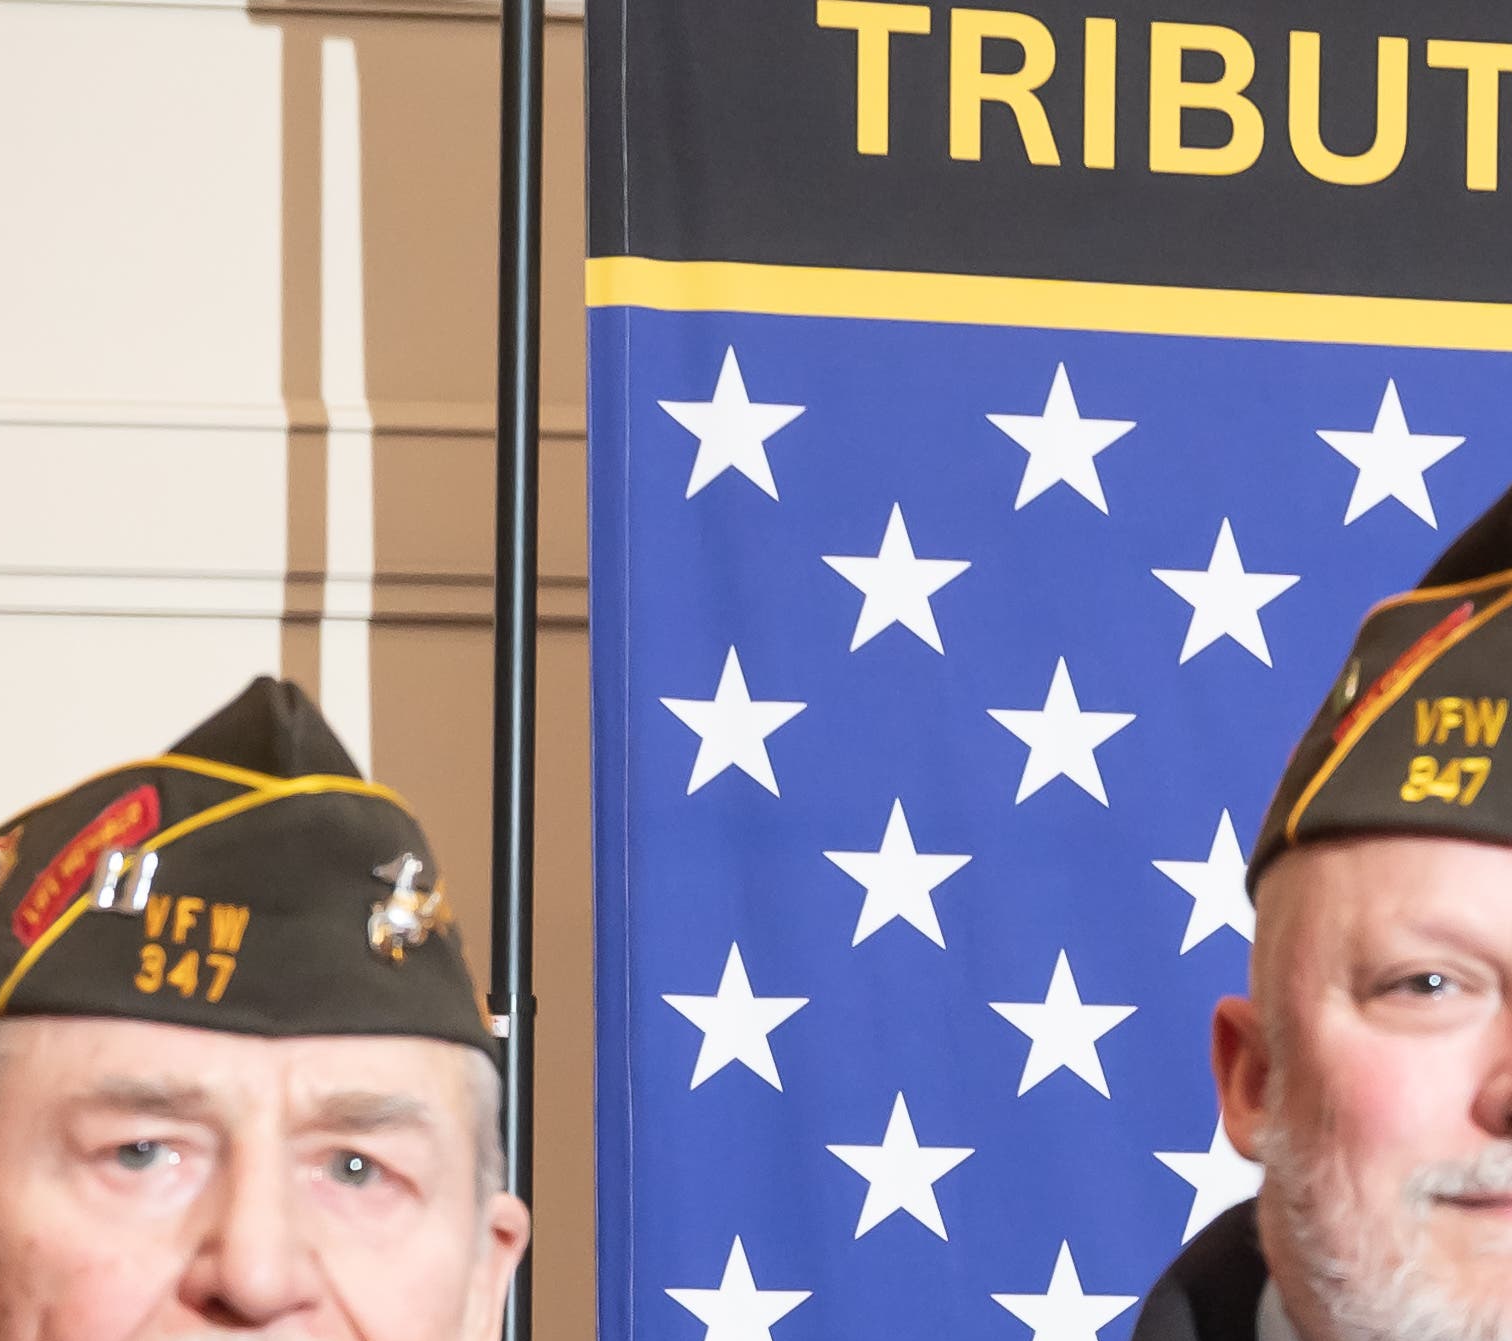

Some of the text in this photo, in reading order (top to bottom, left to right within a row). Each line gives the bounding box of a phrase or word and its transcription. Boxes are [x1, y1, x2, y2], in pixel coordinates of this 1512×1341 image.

[1415, 696, 1508, 748] VFW
[144, 894, 250, 953] VFW
[133, 942, 237, 1004] 347
